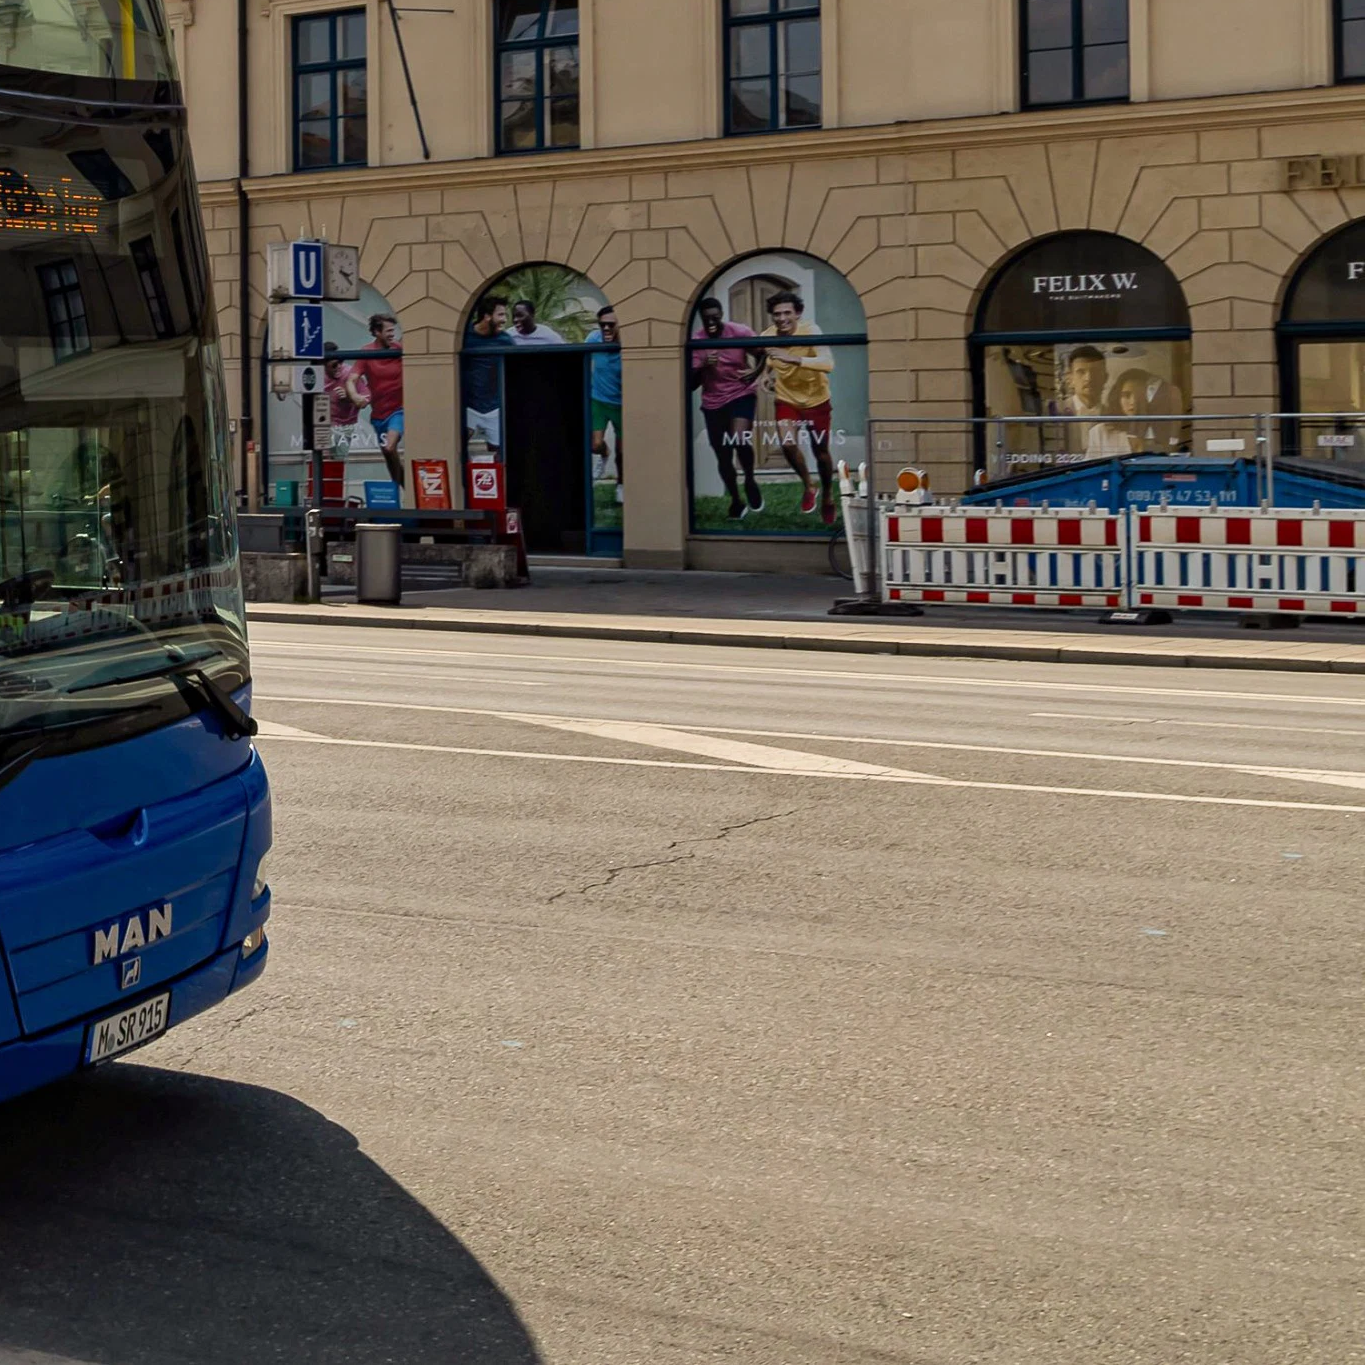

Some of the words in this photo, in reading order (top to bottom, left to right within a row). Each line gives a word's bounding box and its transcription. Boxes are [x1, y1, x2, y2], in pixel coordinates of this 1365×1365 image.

[299, 251, 316, 289] U
[1033, 274, 1106, 293] FELIX
[1111, 272, 1138, 290] W.
[722, 430, 753, 446] MR
[762, 429, 846, 446] MARVIS
[93, 903, 173, 966] MAN
[117, 1012, 136, 1047] SR
[138, 999, 164, 1038] 915
